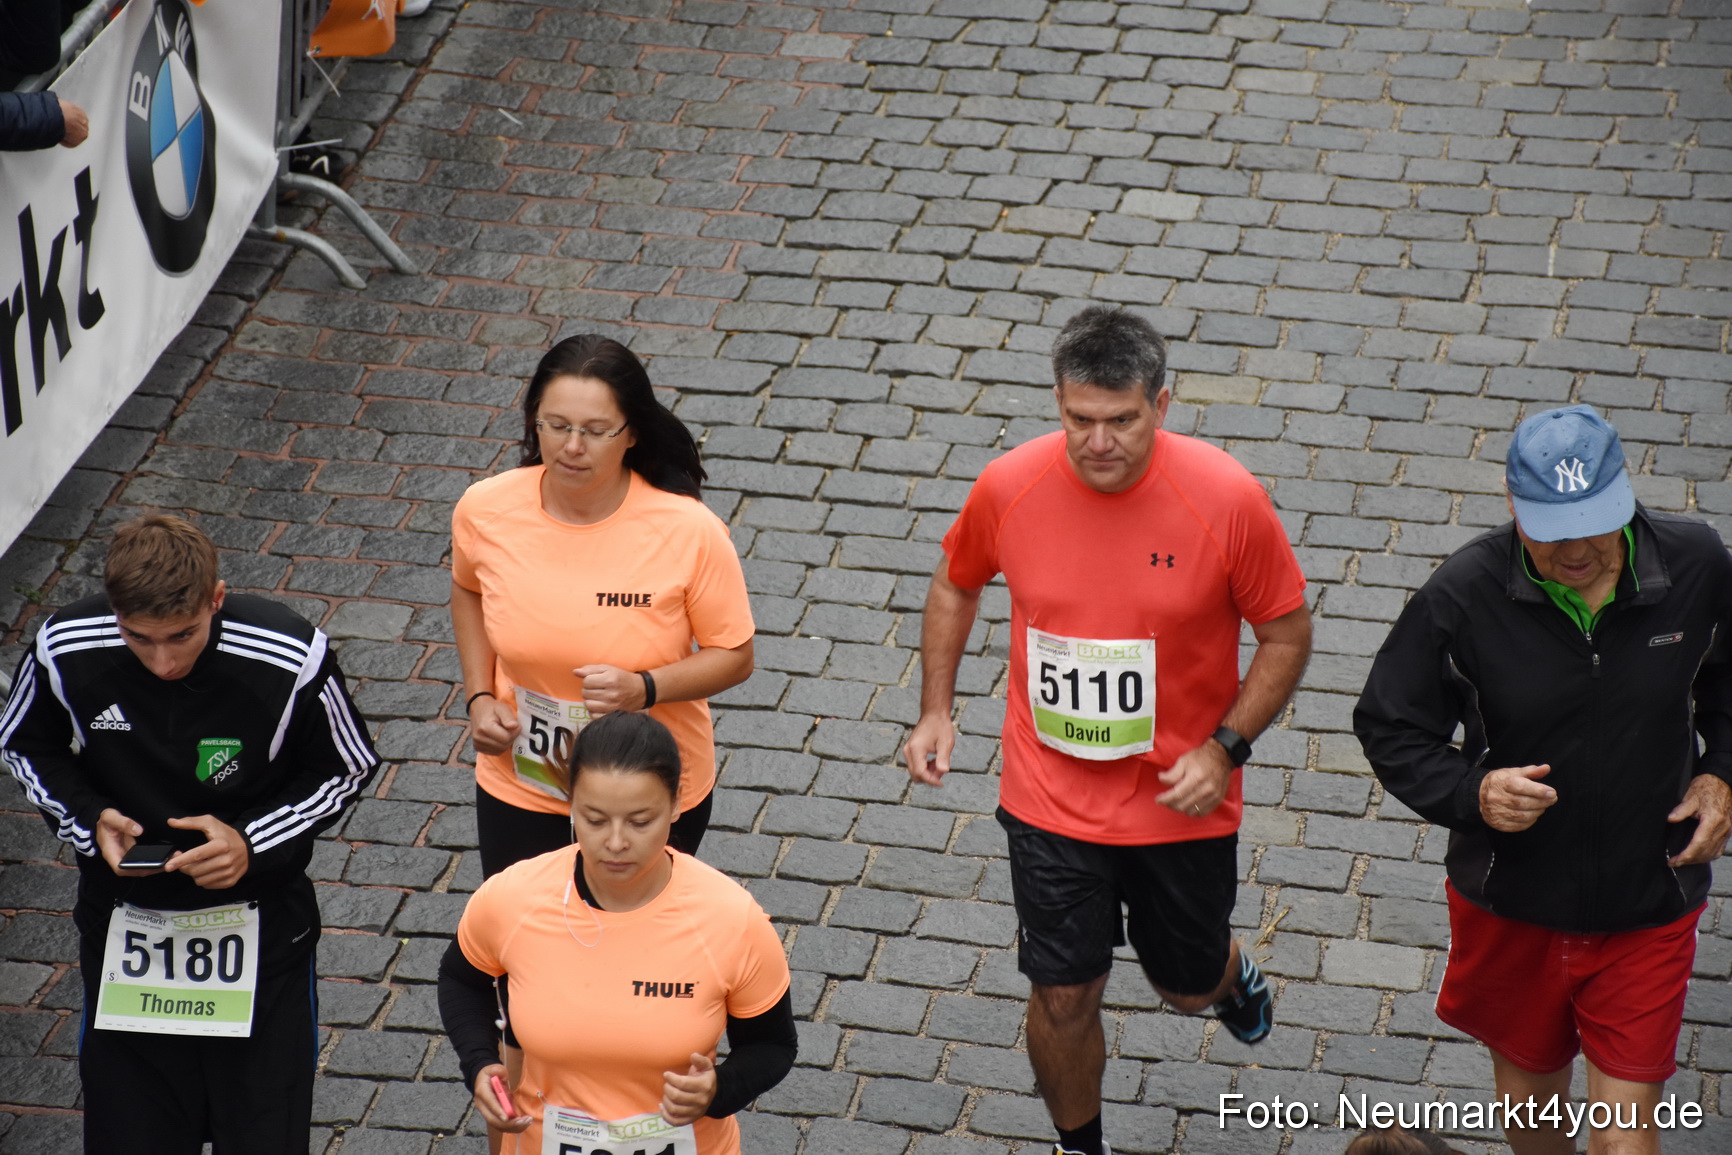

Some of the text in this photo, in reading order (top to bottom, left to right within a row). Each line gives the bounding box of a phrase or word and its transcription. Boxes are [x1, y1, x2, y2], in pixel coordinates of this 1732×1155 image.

[128, 3, 192, 122] BMW
[596, 592, 652, 607] THULE
[1077, 643, 1142, 659] BOCK
[1040, 661, 1143, 714] 5110
[90, 719, 132, 732] adidas
[1065, 721, 1111, 743] David
[207, 747, 230, 776] TSV
[213, 760, 239, 785] 1965
[124, 910, 167, 927] NeuerMarkt
[171, 908, 245, 929] BOCK
[121, 930, 244, 983] 5180
[632, 980, 696, 998] THULE
[140, 993, 216, 1017] Thomas
[554, 1123, 600, 1138] NeuerMarkt
